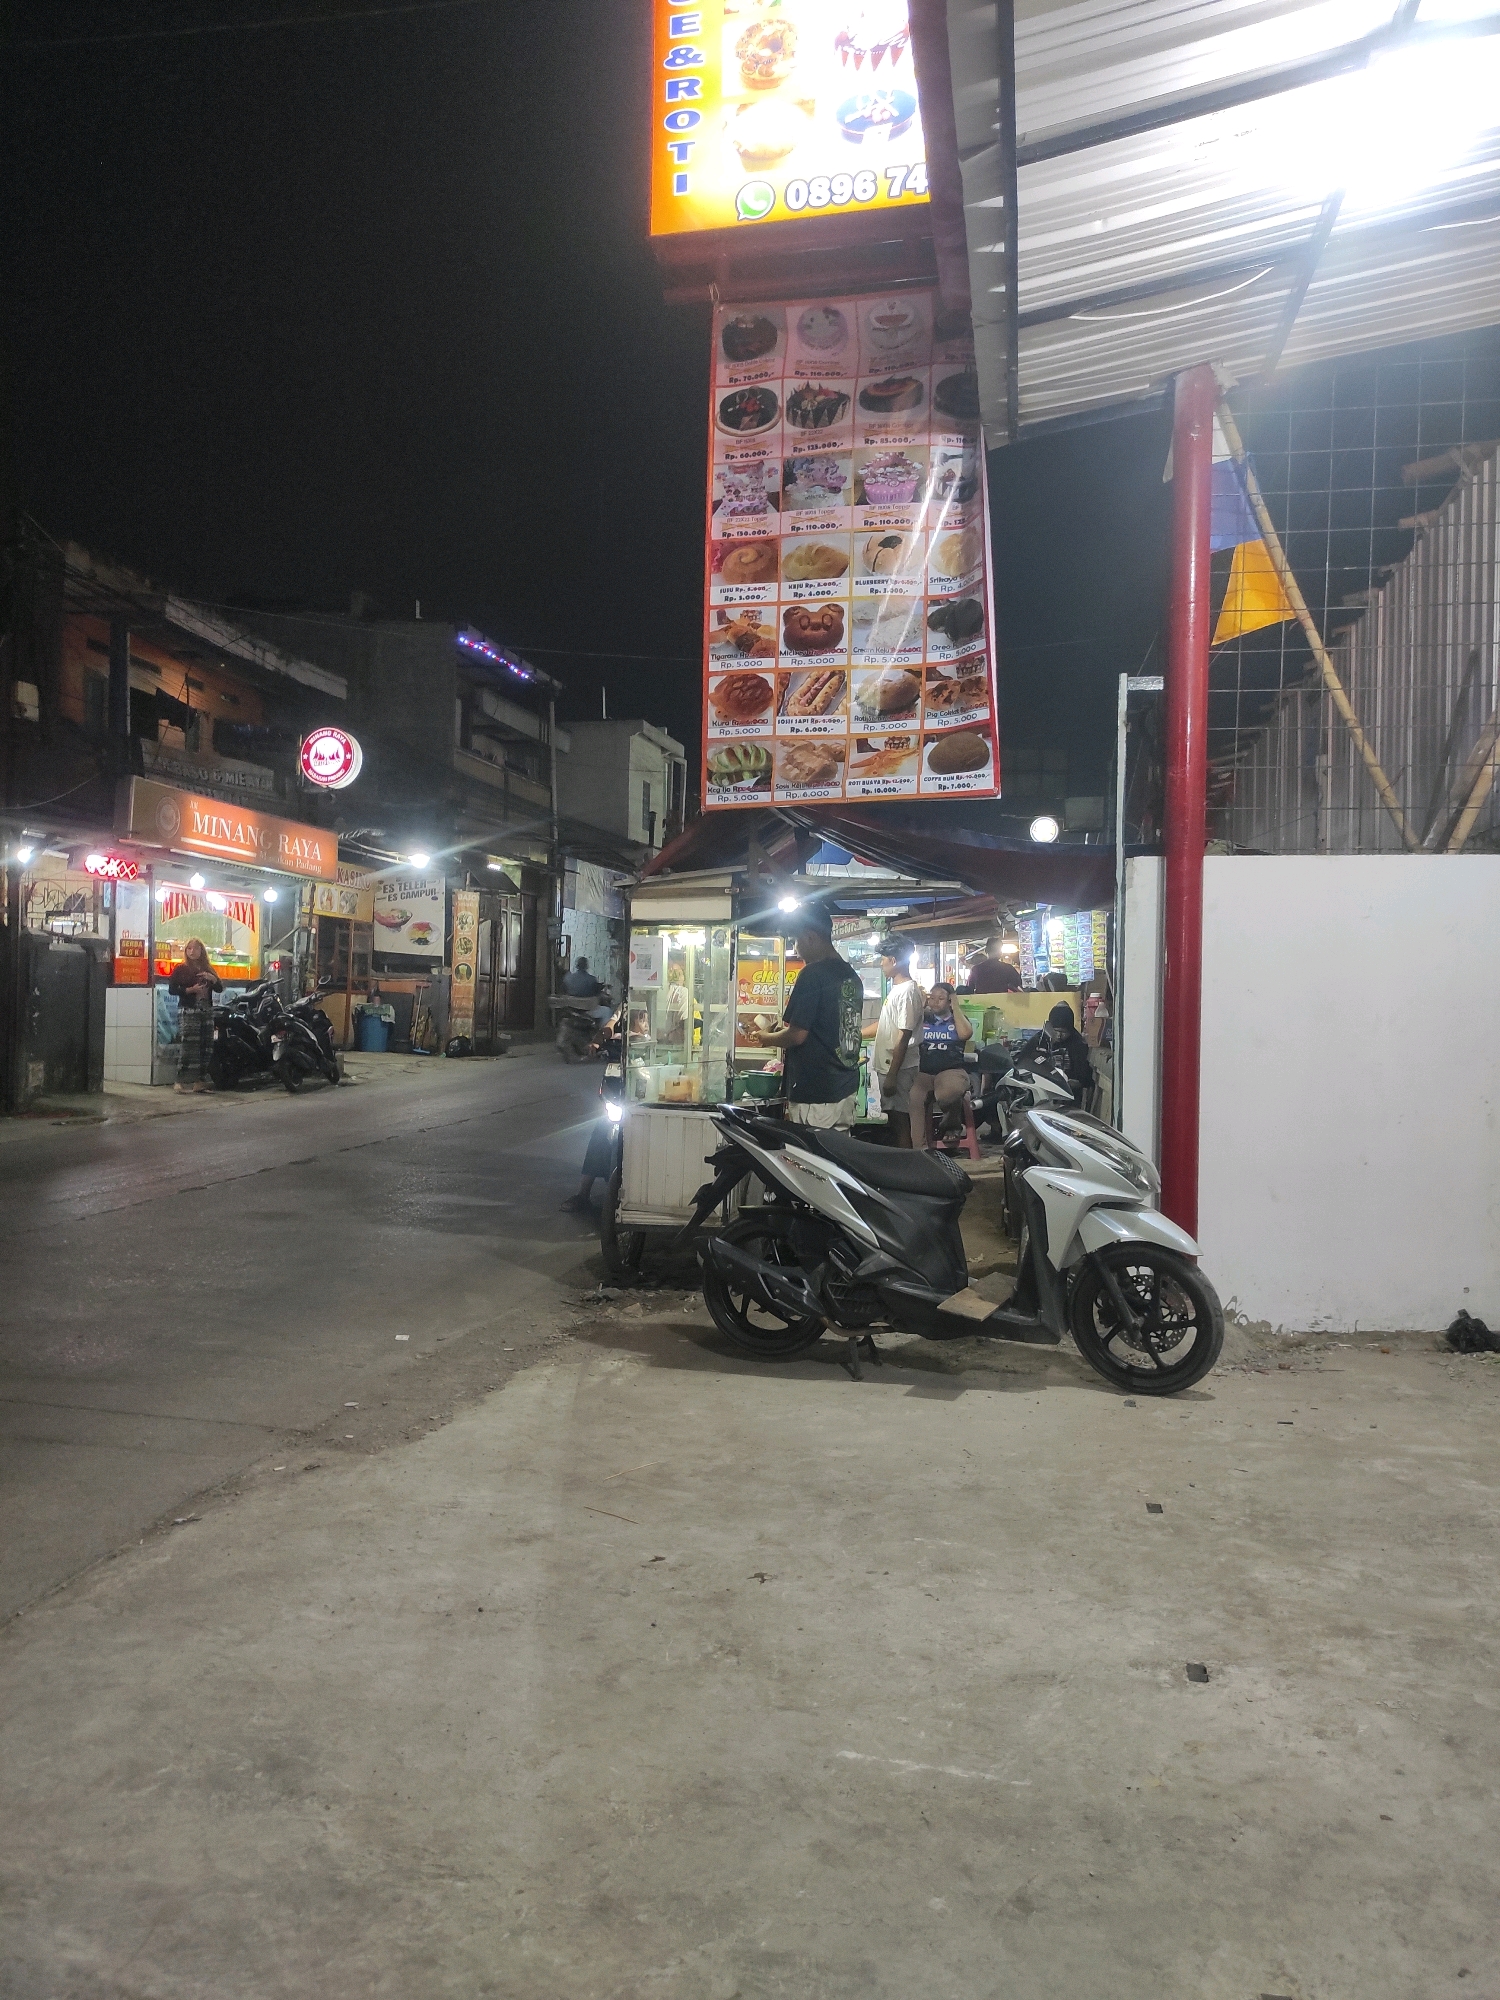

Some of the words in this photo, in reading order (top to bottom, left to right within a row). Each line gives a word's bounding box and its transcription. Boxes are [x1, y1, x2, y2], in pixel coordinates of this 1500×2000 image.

[664, 0, 704, 197] E&ROTI
[784, 171, 877, 211] 0896
[886, 163, 928, 198] 74
[740, 450, 773, 459] 60.000,-
[806, 522, 843, 531] 110.000,-
[863, 519, 877, 527] Rp.
[870, 587, 882, 595] Rp.
[724, 595, 737, 603] Rp.
[940, 651, 954, 660] Rp.
[955, 643, 977, 656] 5.000
[720, 661, 734, 669] Rp.
[736, 660, 763, 668] 5.000
[807, 657, 835, 665] 5.000
[864, 656, 879, 664] Rp.
[937, 718, 952, 727] Rp.
[953, 713, 978, 725] 5.000
[719, 728, 734, 736] Rp.
[735, 727, 761, 735] 5.000
[790, 726, 803, 734] Rp.
[804, 726, 834, 734] 6.000,-
[863, 723, 878, 732] Rp.
[880, 722, 908, 731] 5.000
[309, 731, 332, 745] MINANG
[333, 731, 347, 744] RAYA
[938, 783, 950, 791] Rp.
[785, 791, 800, 800] Rp.
[802, 790, 830, 798] 6.000
[861, 788, 873, 796] Rp.
[717, 795, 732, 803] Rp.
[733, 794, 759, 802] 5.000
[192, 811, 271, 850] MINANG
[278, 833, 322, 861] RAYA
[295, 858, 322, 875] Padang
[383, 884, 395, 894] ES
[398, 880, 427, 891] TELER
[387, 893, 398, 902] ES
[400, 888, 437, 900] CAMPUR
[222, 901, 256, 934] RAYA
